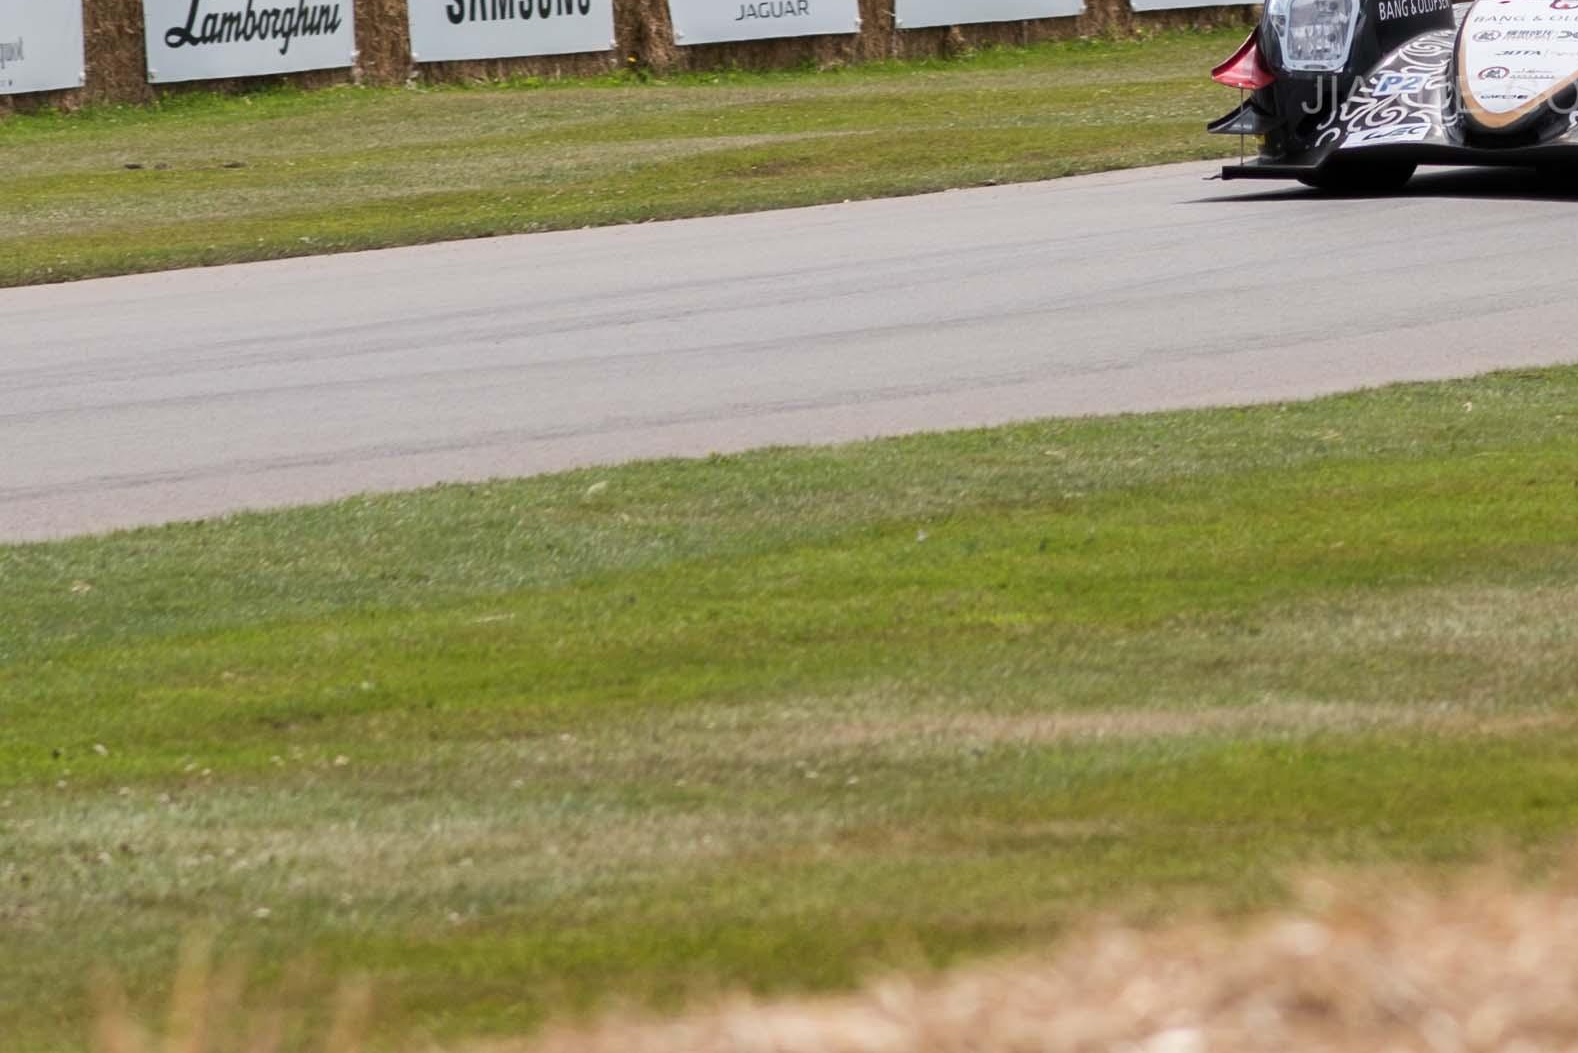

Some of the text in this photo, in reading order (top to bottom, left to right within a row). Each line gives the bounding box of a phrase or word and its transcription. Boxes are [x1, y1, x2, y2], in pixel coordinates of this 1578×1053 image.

[1473, 14, 1524, 24] BANG
[1532, 14, 1543, 22] &
[1379, 76, 1422, 92] P2
